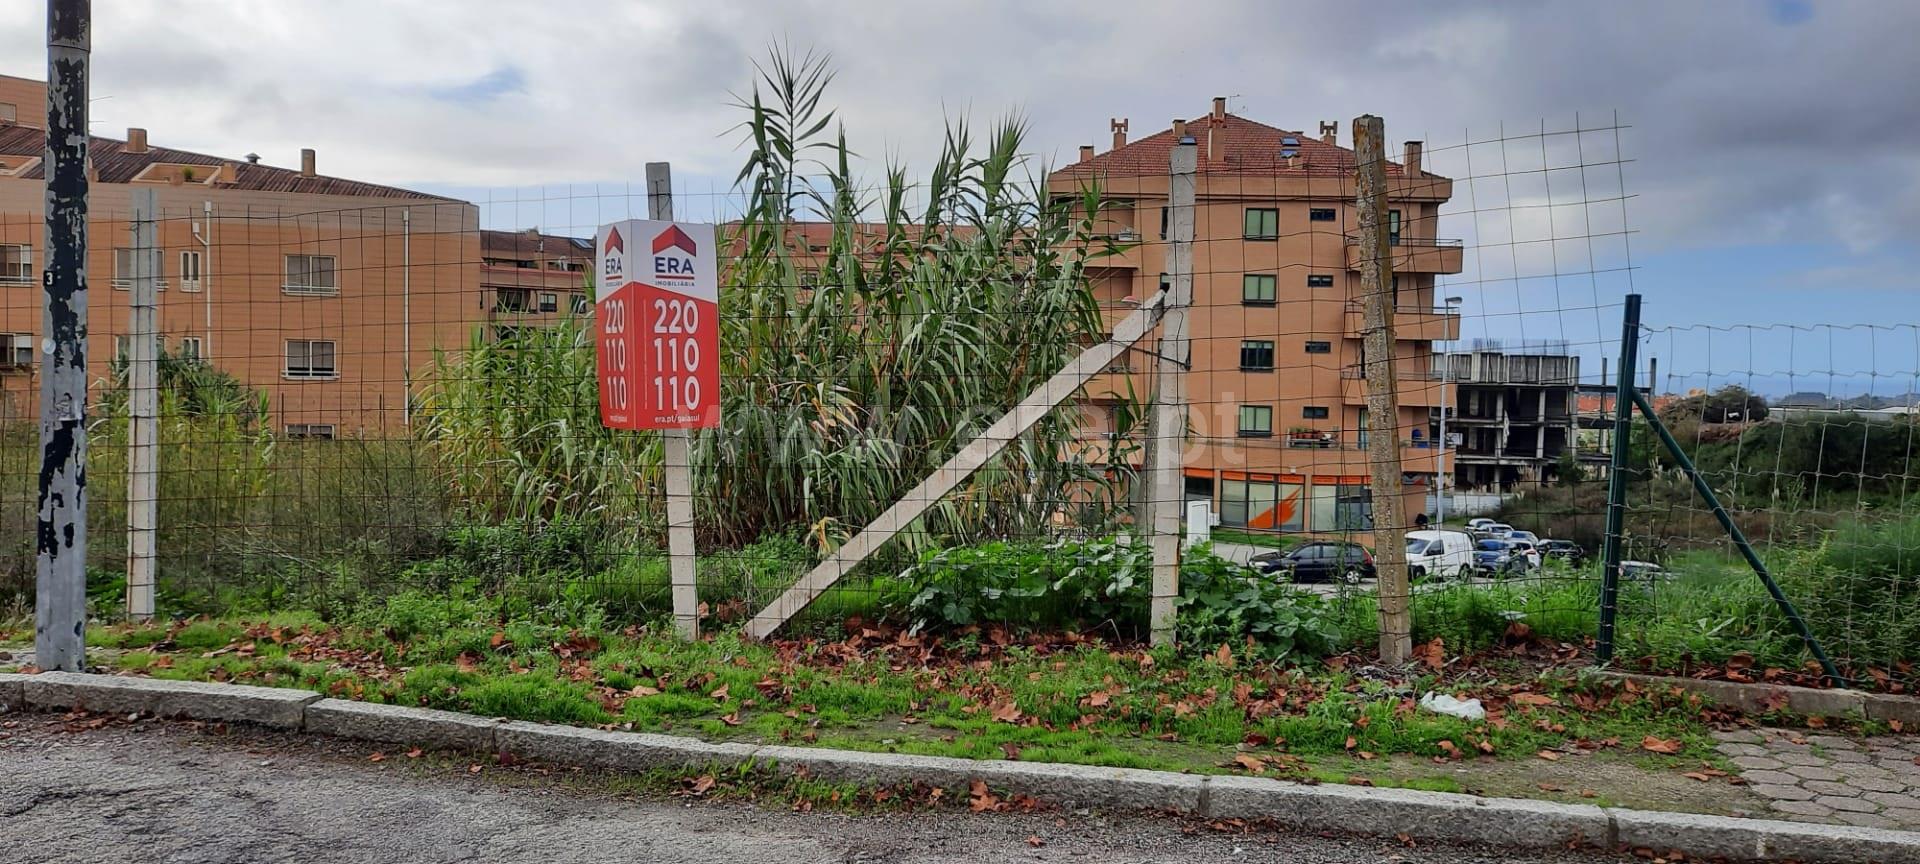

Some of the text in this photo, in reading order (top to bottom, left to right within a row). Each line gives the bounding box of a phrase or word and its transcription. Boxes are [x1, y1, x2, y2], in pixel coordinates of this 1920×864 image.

[46, 272, 53, 285] 3
[605, 257, 622, 274] ERA
[654, 256, 695, 275] ERA
[605, 299, 625, 334] 220
[654, 298, 699, 334] 220
[605, 337, 626, 373] 110
[654, 337, 700, 373] 110
[607, 375, 627, 411] 110
[654, 375, 701, 411] 110
